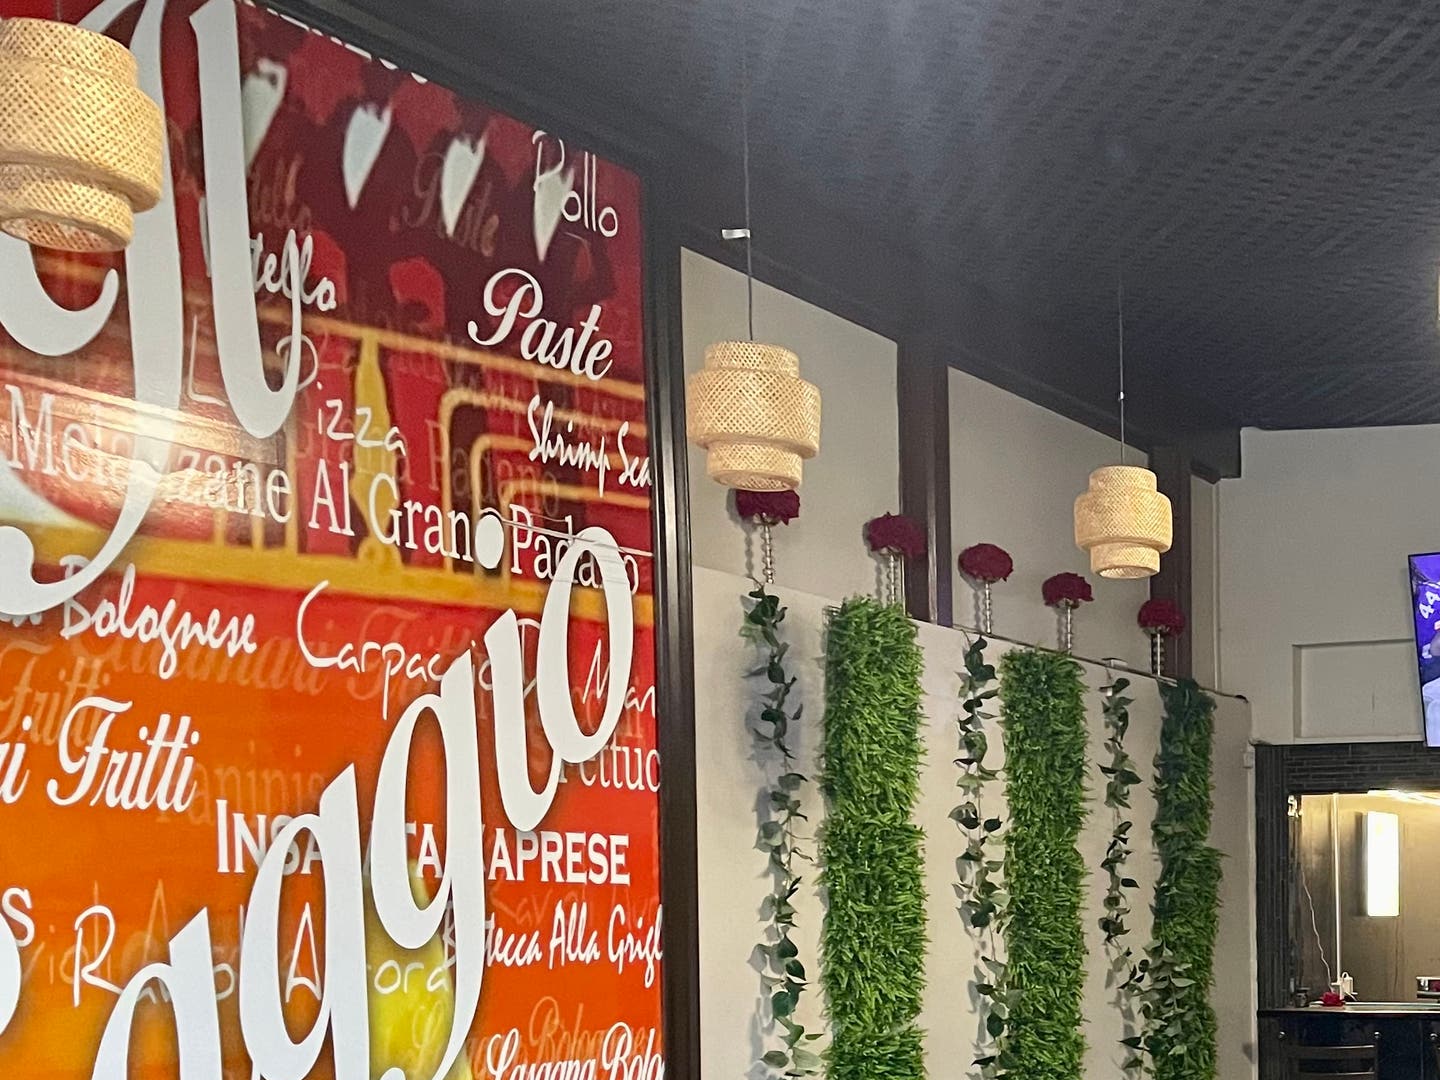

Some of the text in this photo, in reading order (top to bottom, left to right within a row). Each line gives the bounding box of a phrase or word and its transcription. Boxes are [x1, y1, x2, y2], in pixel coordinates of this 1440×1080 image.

[532, 130, 618, 238] Pollo
[467, 268, 613, 380] Paste
[307, 457, 355, 537] Al
[528, 394, 611, 498] Shrimp
[59, 553, 257, 681] Bolognese
[46, 696, 200, 813] Fritti
[549, 900, 600, 970] Alla
